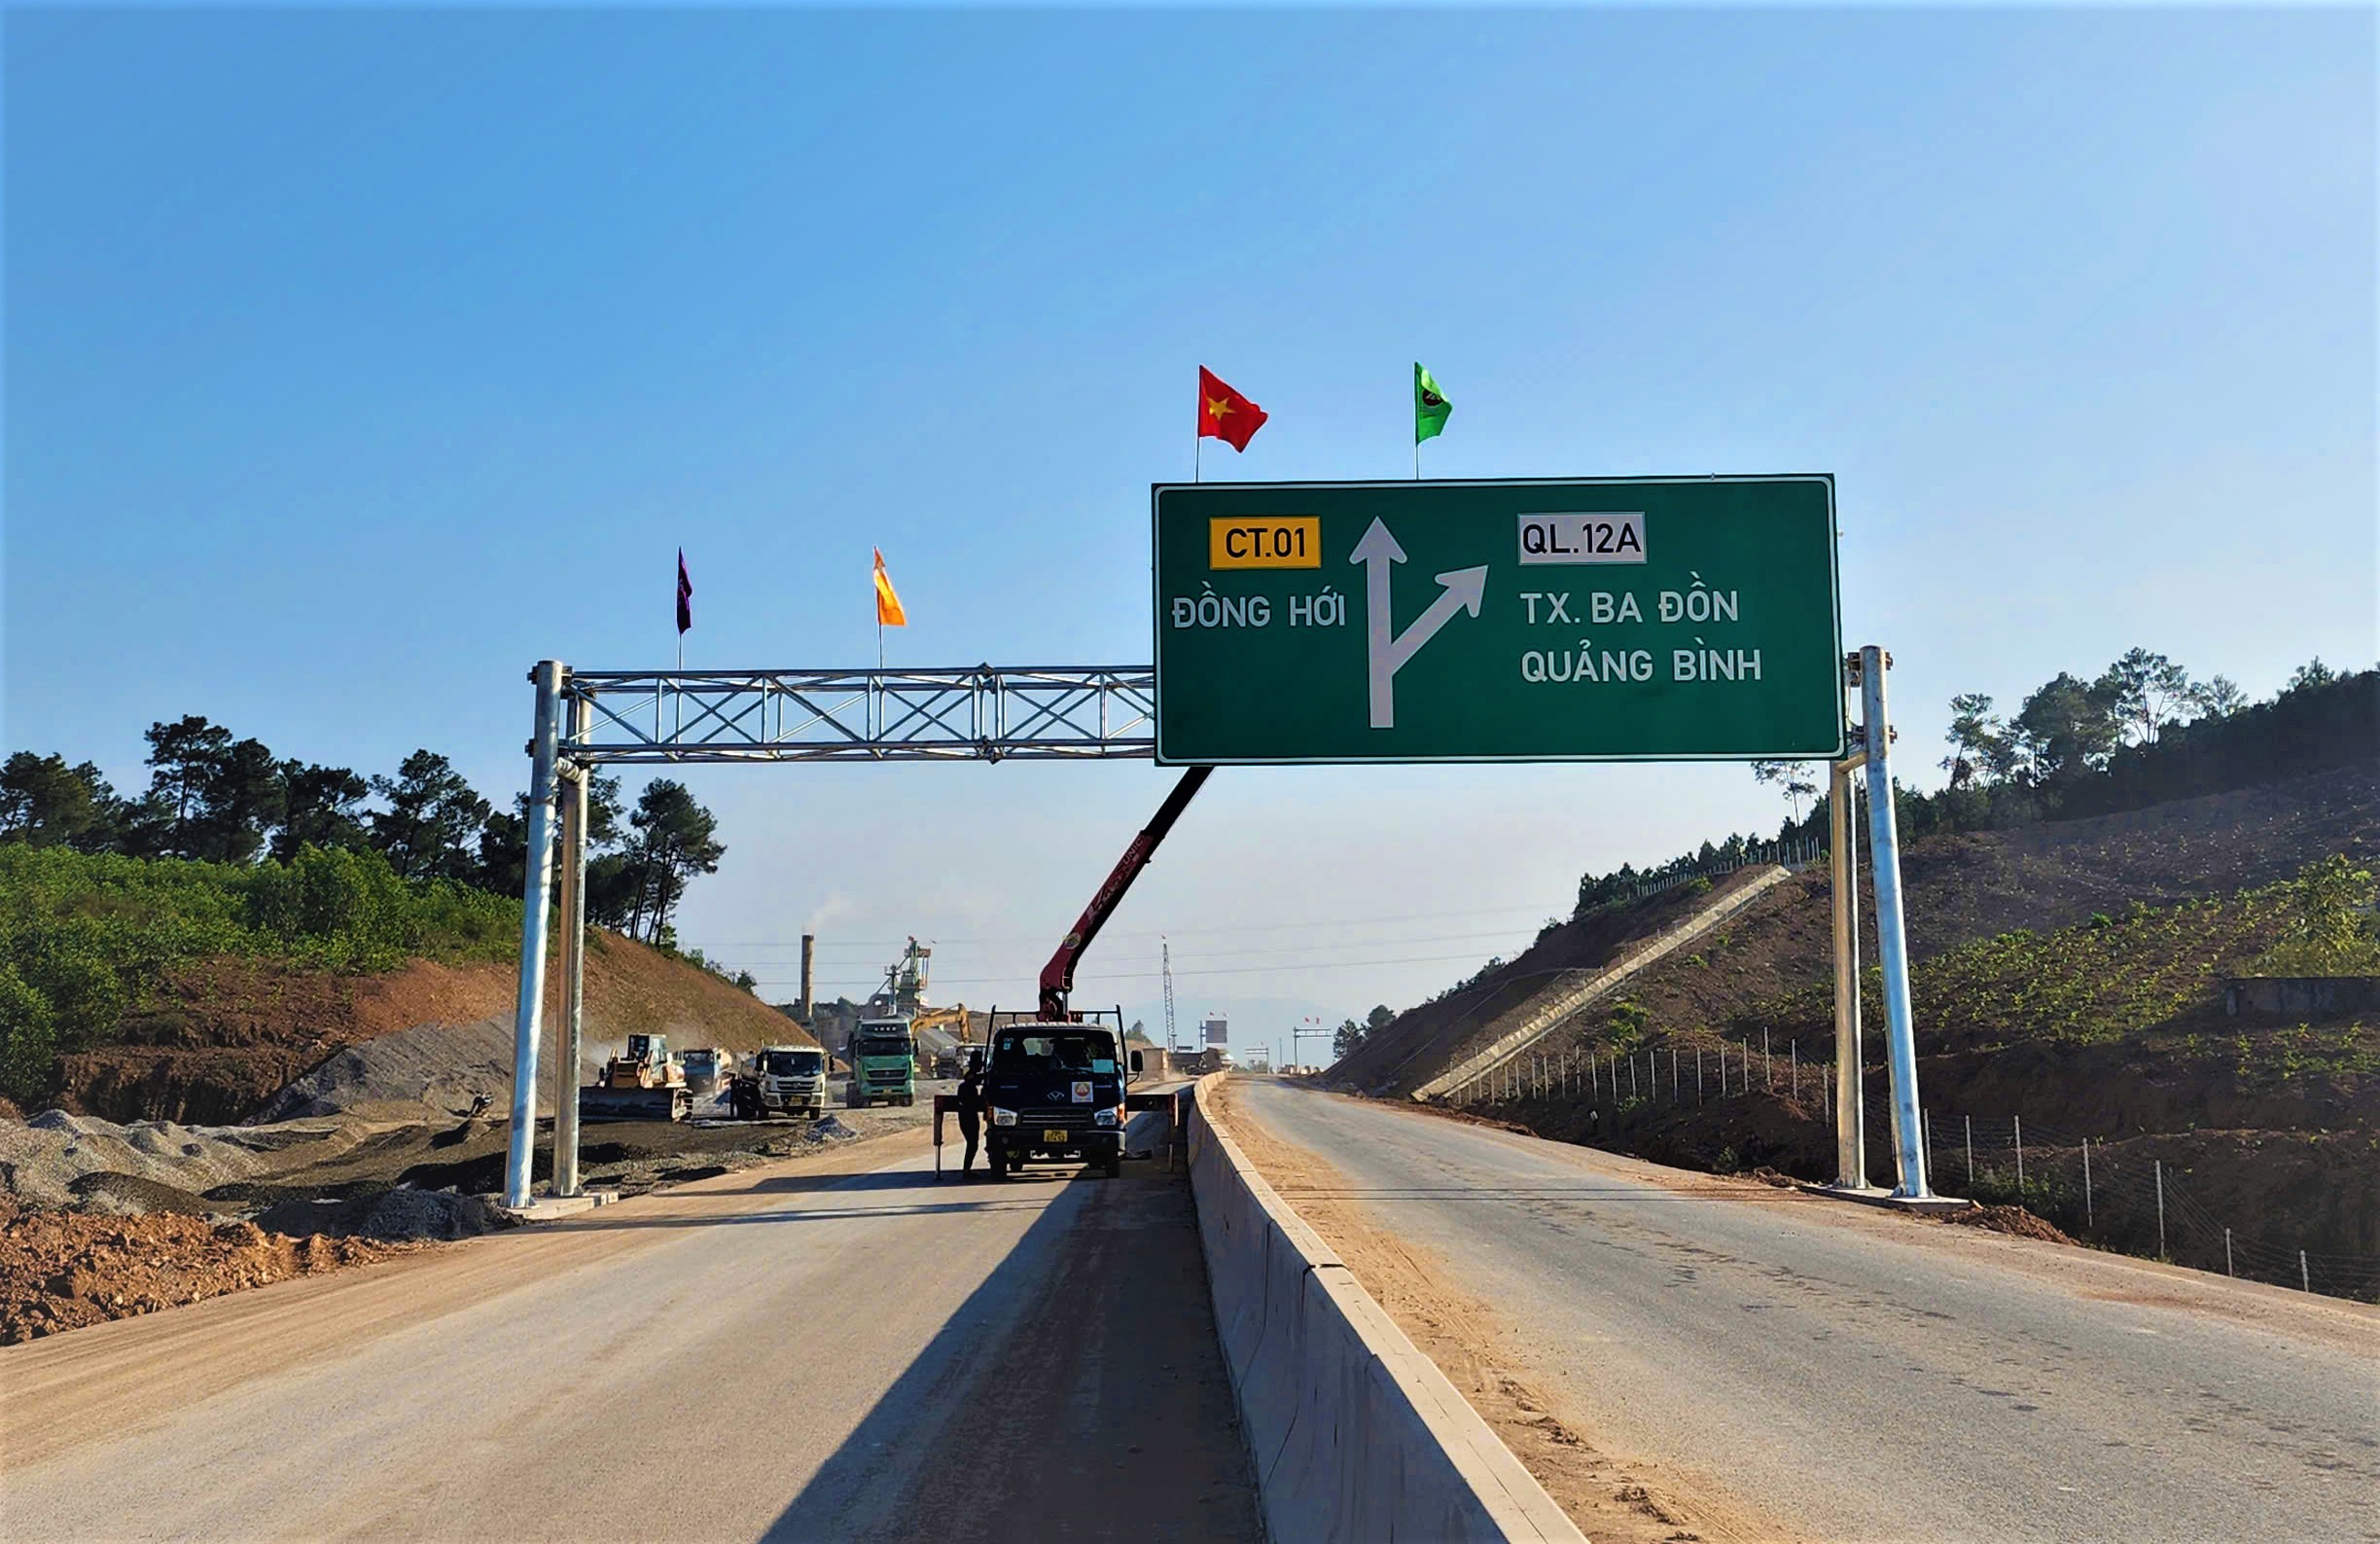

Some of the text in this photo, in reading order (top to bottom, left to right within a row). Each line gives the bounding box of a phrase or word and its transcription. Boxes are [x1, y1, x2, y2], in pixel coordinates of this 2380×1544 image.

[1226, 527, 1305, 558] CT.01
[1522, 522, 1642, 555] QL.12A
[1172, 581, 1345, 628] ĐỒNG HỚI
[1519, 571, 1738, 625] TX. BA ĐỒN
[1521, 636, 1761, 683] QUẢNG BÌNH
[1122, 838, 1144, 865] UNIC
